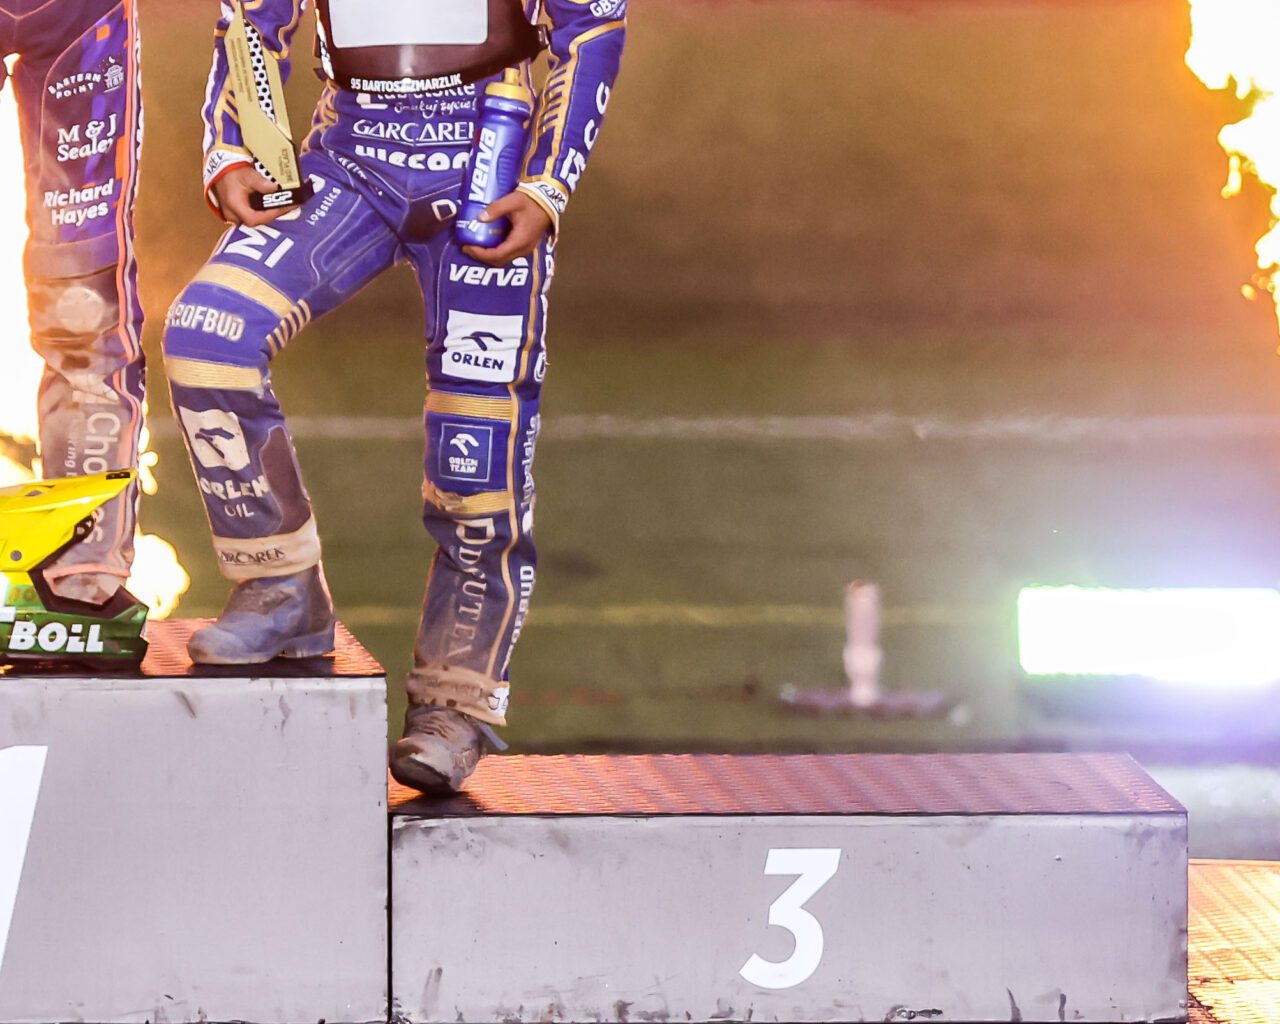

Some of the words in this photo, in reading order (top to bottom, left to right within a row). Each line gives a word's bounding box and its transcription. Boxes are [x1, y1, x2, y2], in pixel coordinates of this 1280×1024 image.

[47, 72, 102, 95] EASTERN
[55, 82, 95, 100] POINT
[350, 77, 362, 90] 95
[57, 125, 80, 144] M
[85, 120, 105, 139] &
[106, 114, 117, 137] J
[468, 127, 497, 203] verva
[43, 178, 115, 208] Richard
[262, 190, 293, 203] SGP
[51, 201, 109, 227] Hayes
[448, 263, 529, 287] verva
[165, 303, 245, 342] ROFBUD
[451, 351, 505, 371] ORLEN
[448, 456, 479, 467] ORLEN
[449, 464, 478, 474] TEAM
[200, 475, 270, 501] ORLEN
[224, 503, 255, 519] OIL
[8, 620, 104, 653] BOLL
[738, 848, 842, 989] 3
